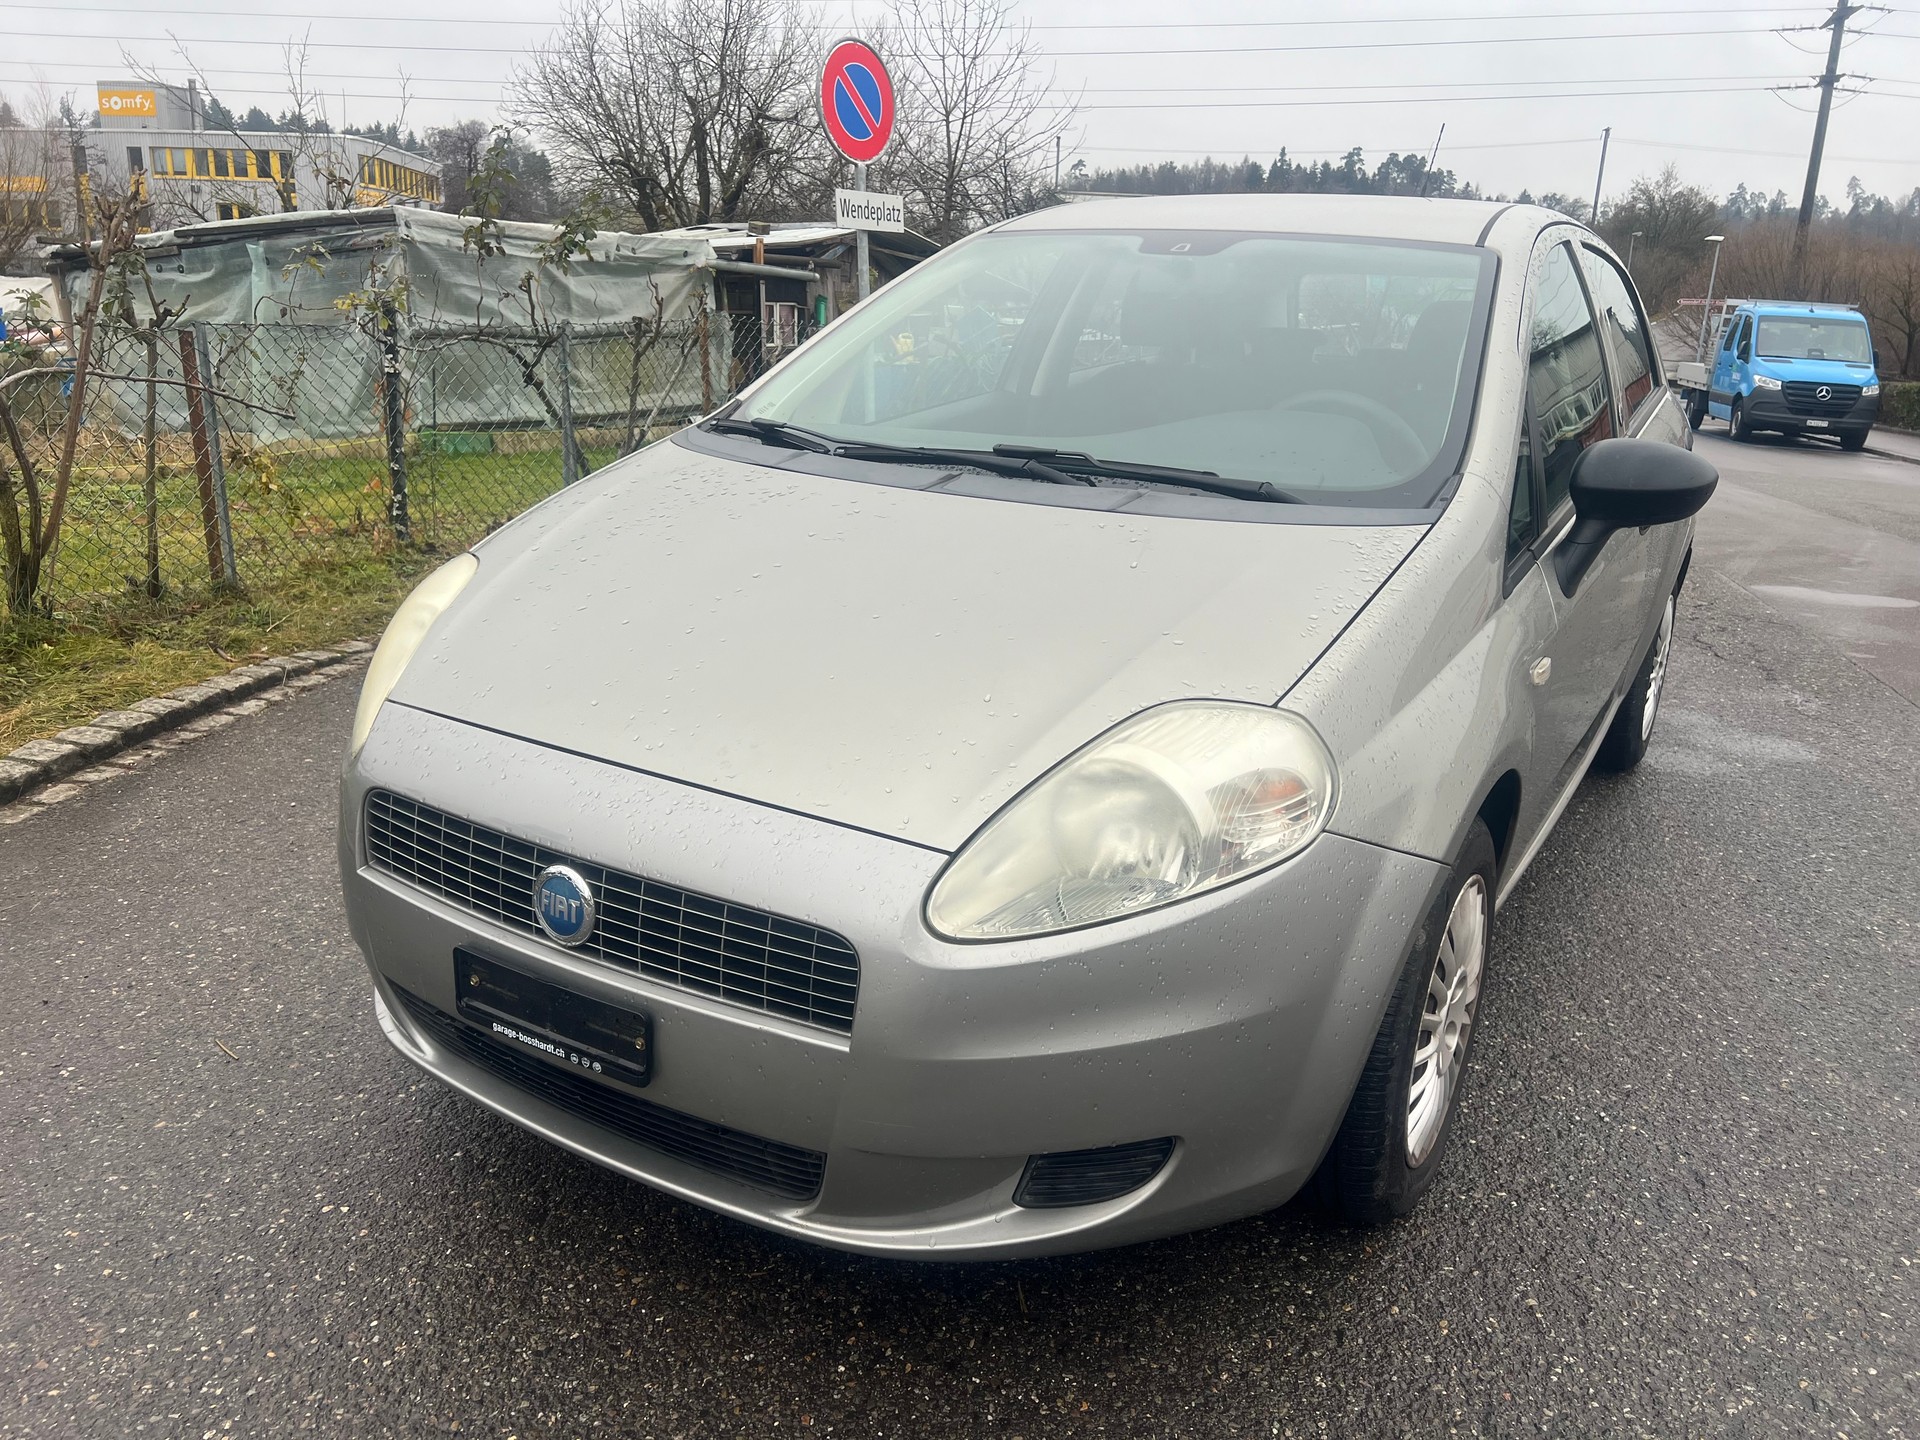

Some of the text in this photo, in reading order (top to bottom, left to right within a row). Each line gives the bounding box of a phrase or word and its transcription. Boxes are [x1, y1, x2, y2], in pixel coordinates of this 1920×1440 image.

[839, 197, 902, 226] Wendeplatz
[540, 888, 580, 924] FIAT
[492, 1022, 566, 1058] garage-bosshardt.ch
